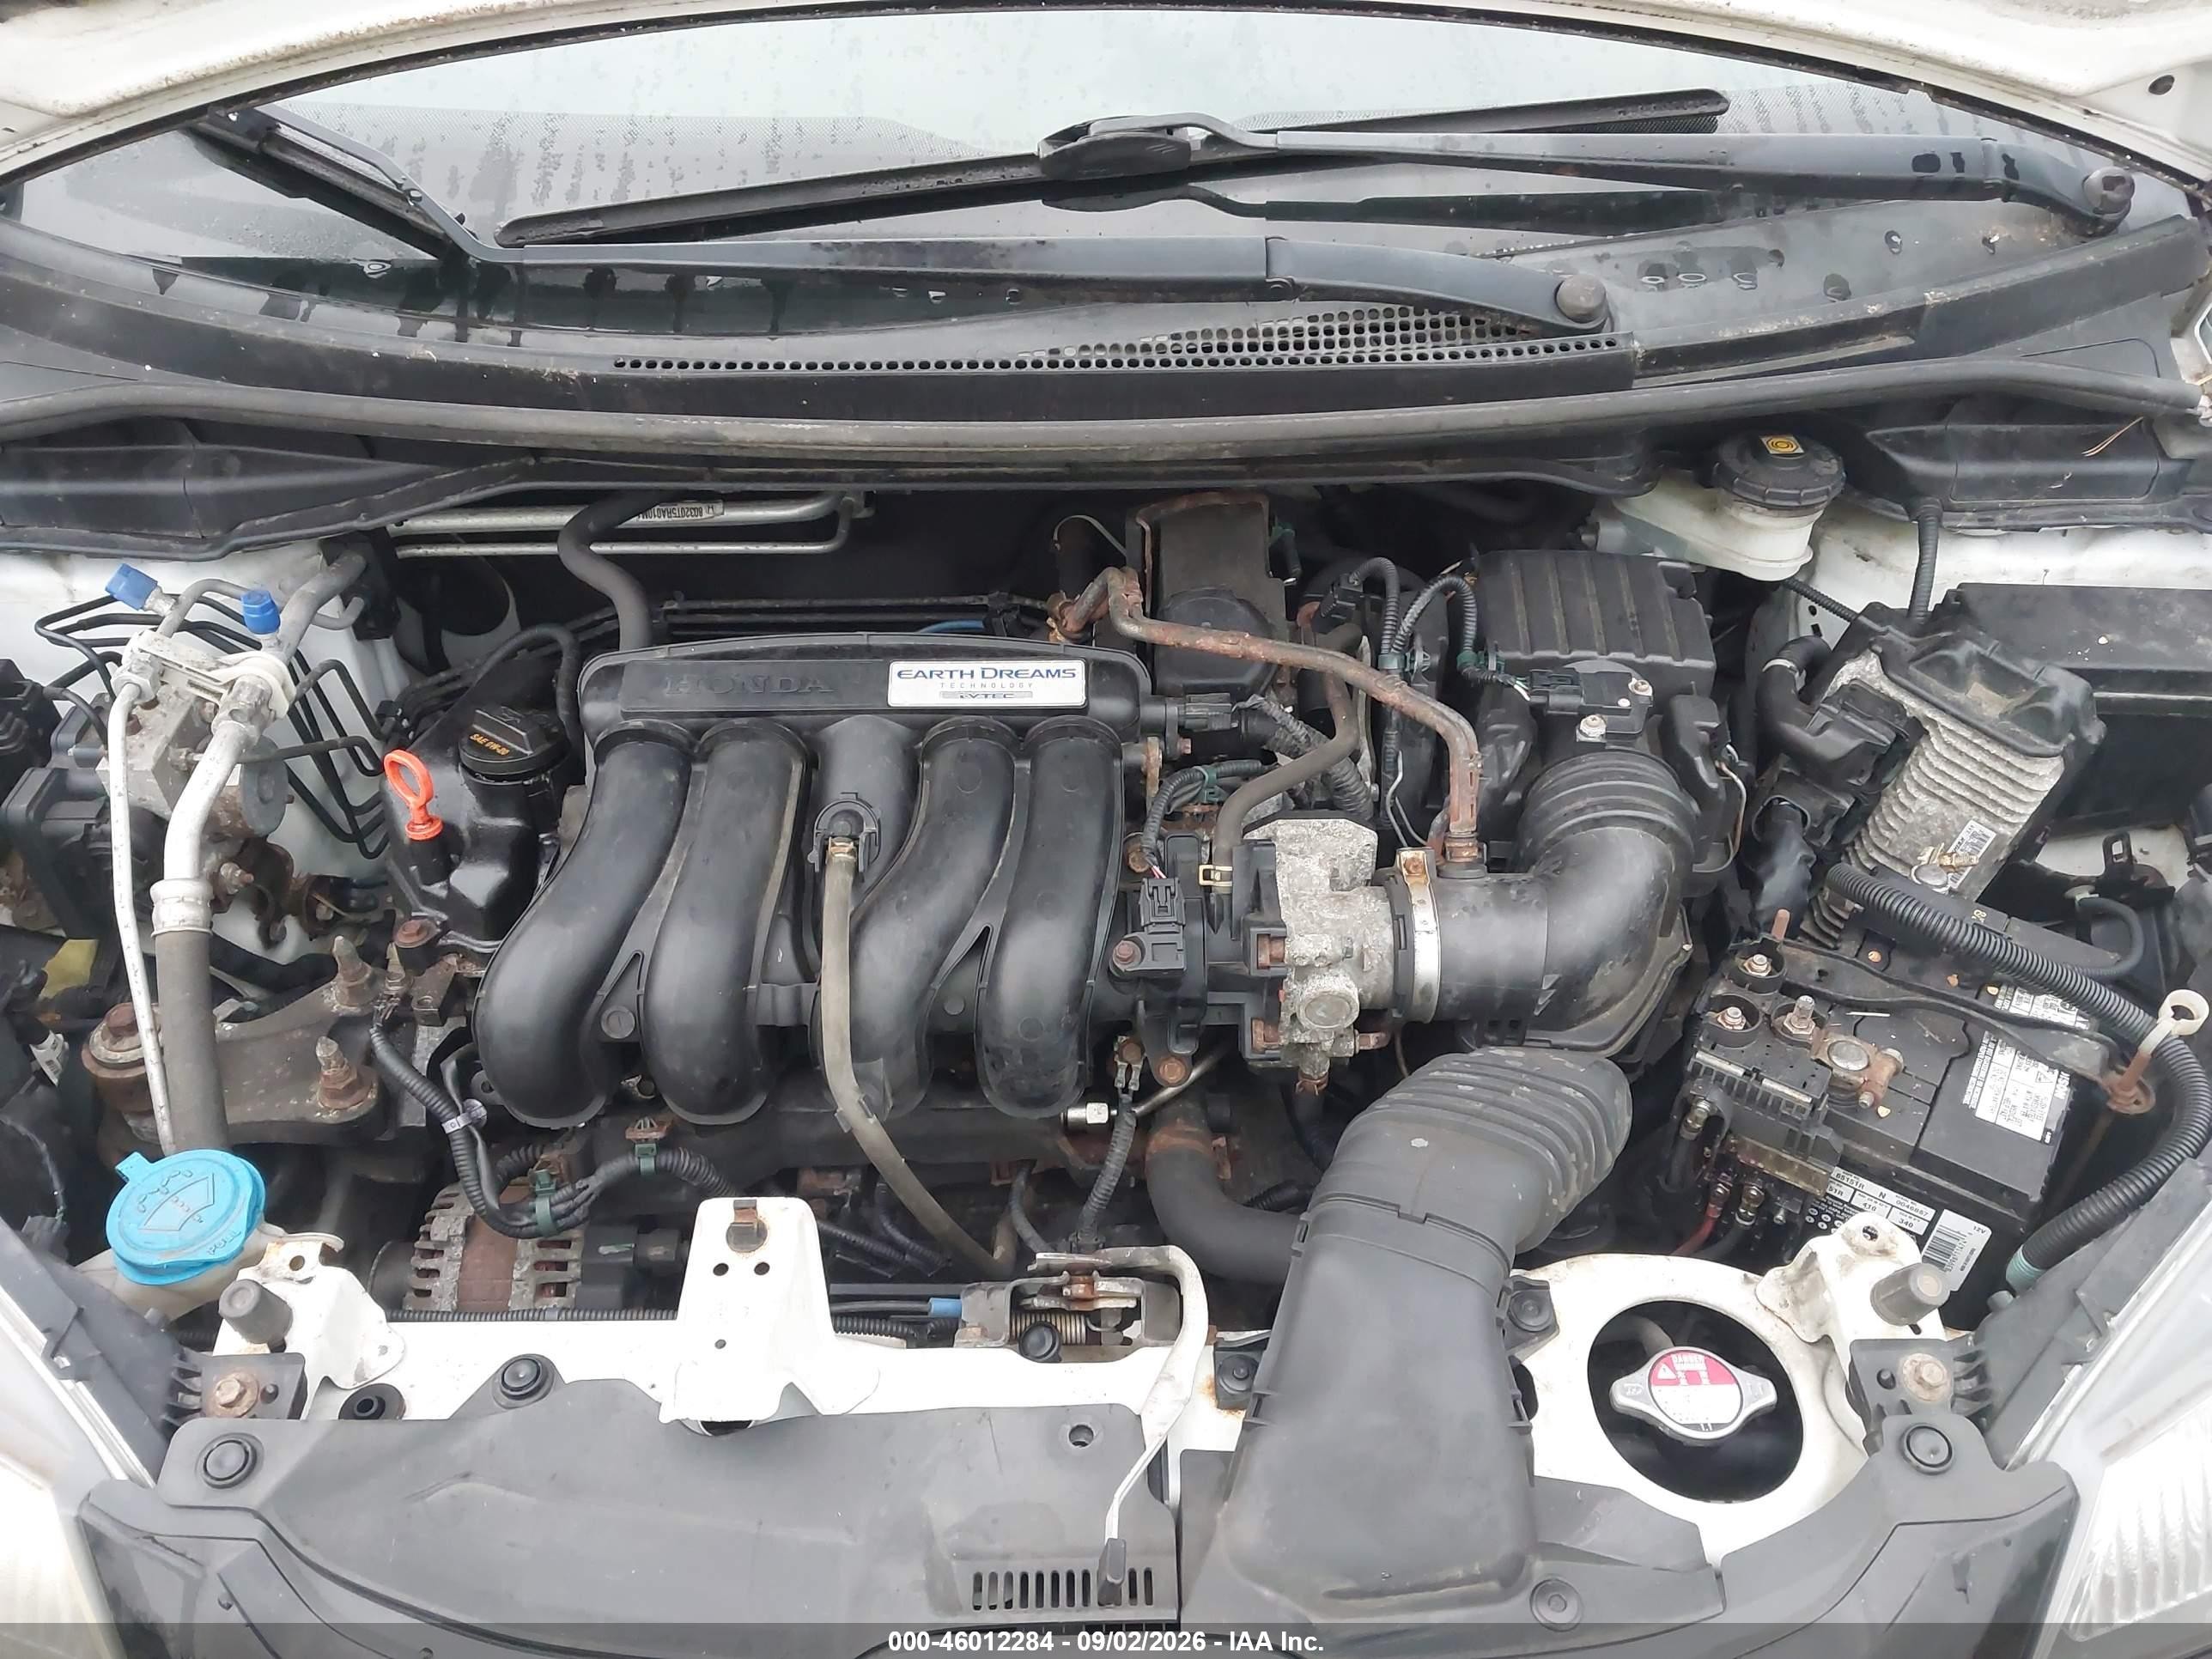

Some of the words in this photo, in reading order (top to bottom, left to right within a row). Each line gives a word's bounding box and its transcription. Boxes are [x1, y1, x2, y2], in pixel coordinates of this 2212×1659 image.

[897, 669, 975, 679] EARTH
[981, 666, 1076, 679] DREAMS
[665, 673, 835, 695] HONDA
[470, 733, 489, 744] SAE
[1878, 1191, 1887, 1200] N
[1898, 1218, 1914, 1229] 340
[1973, 1225, 1985, 1234] 12V
